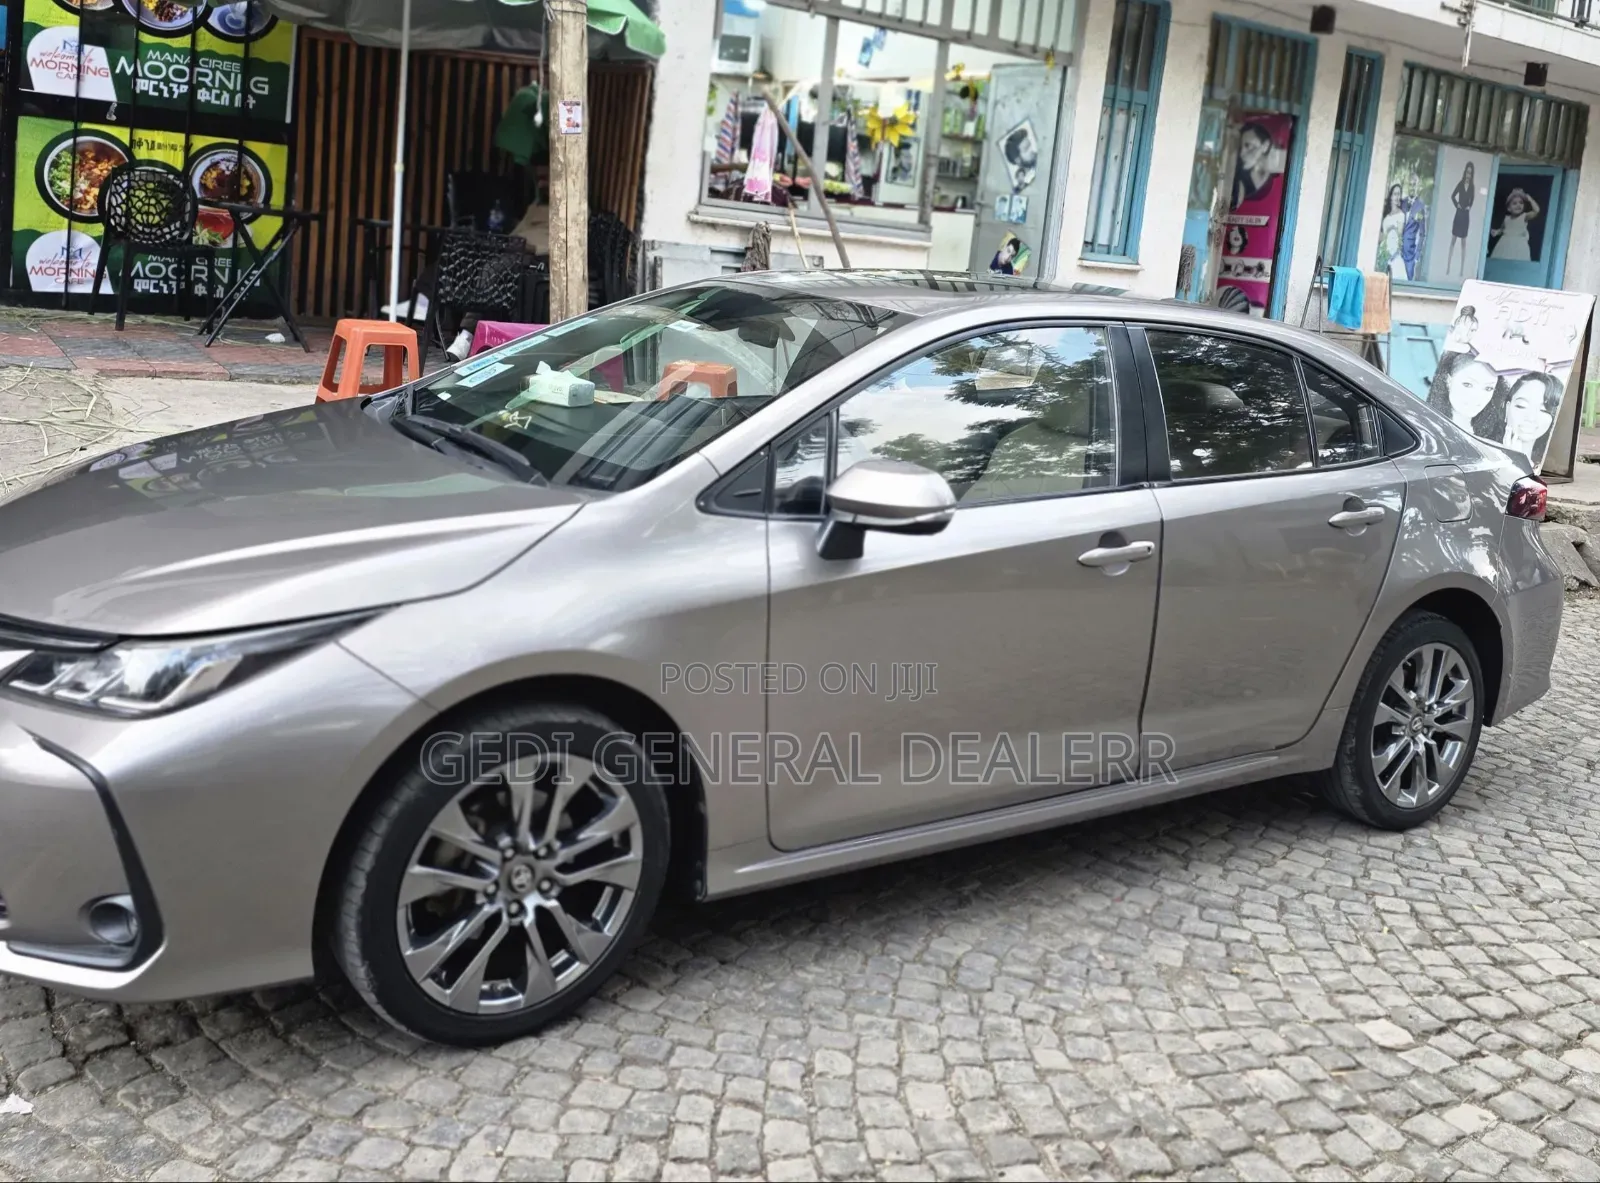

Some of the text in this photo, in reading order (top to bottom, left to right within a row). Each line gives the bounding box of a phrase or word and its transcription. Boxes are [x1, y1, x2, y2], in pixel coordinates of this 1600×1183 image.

[30, 57, 110, 78] MORNING
[199, 57, 241, 72] CIREE
[115, 55, 269, 95] MOORNIG
[29, 265, 107, 279] MORNIN
